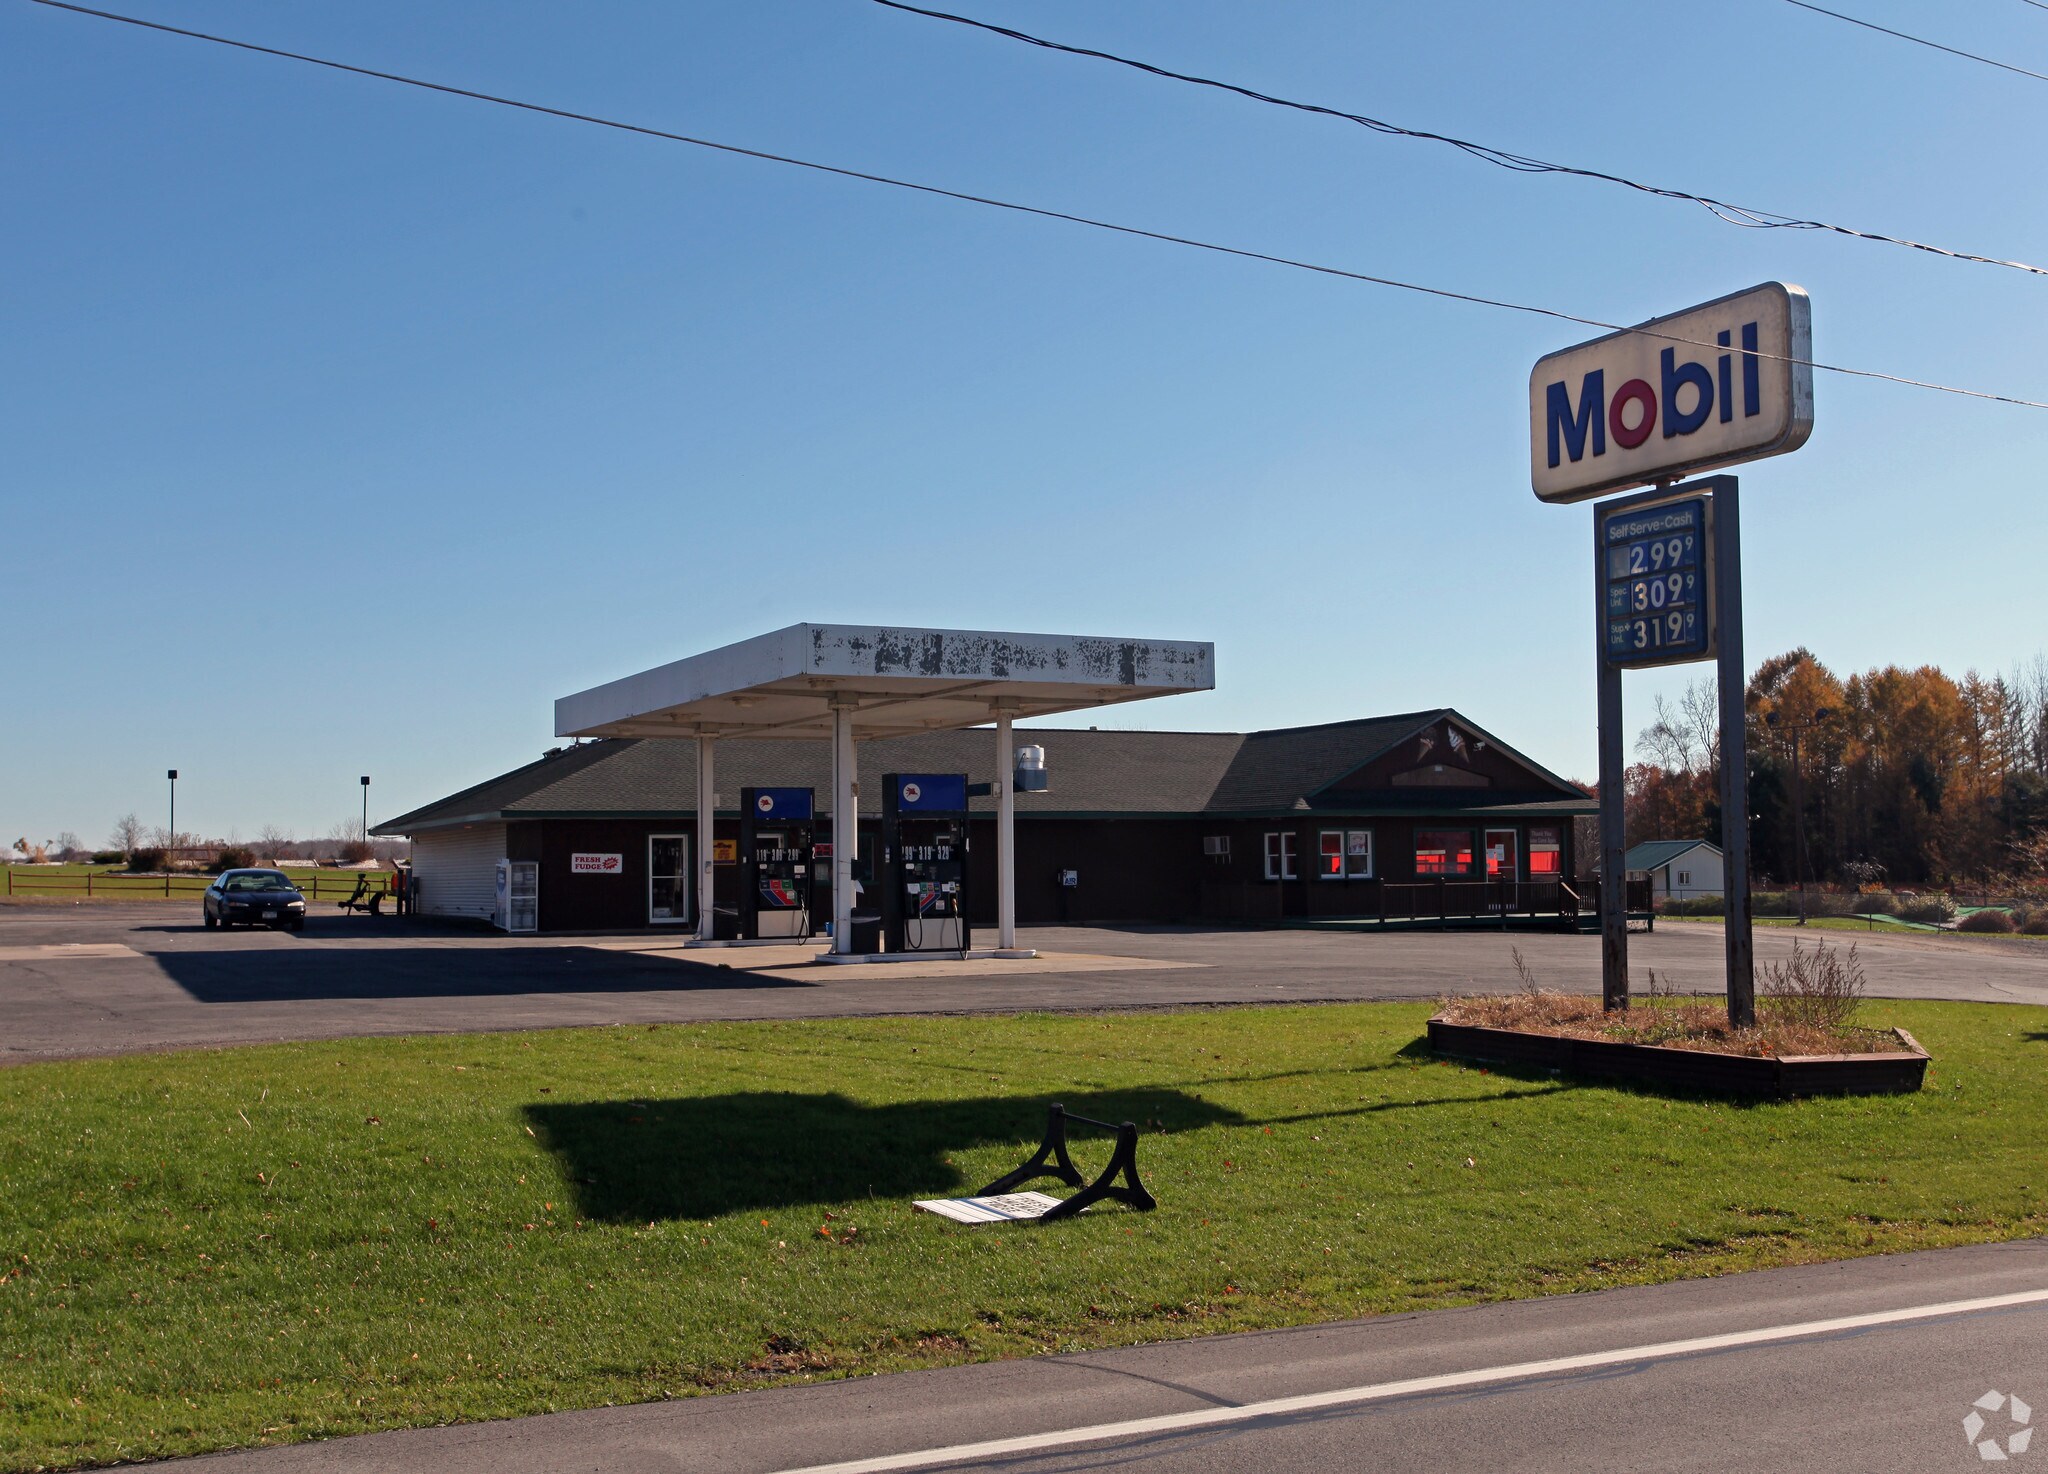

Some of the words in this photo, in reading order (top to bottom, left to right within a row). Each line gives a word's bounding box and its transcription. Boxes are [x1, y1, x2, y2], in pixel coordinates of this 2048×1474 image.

[1546, 321, 1760, 469] Mobil
[1609, 524, 1628, 539] Self
[1065, 877, 1076, 885] AIR
